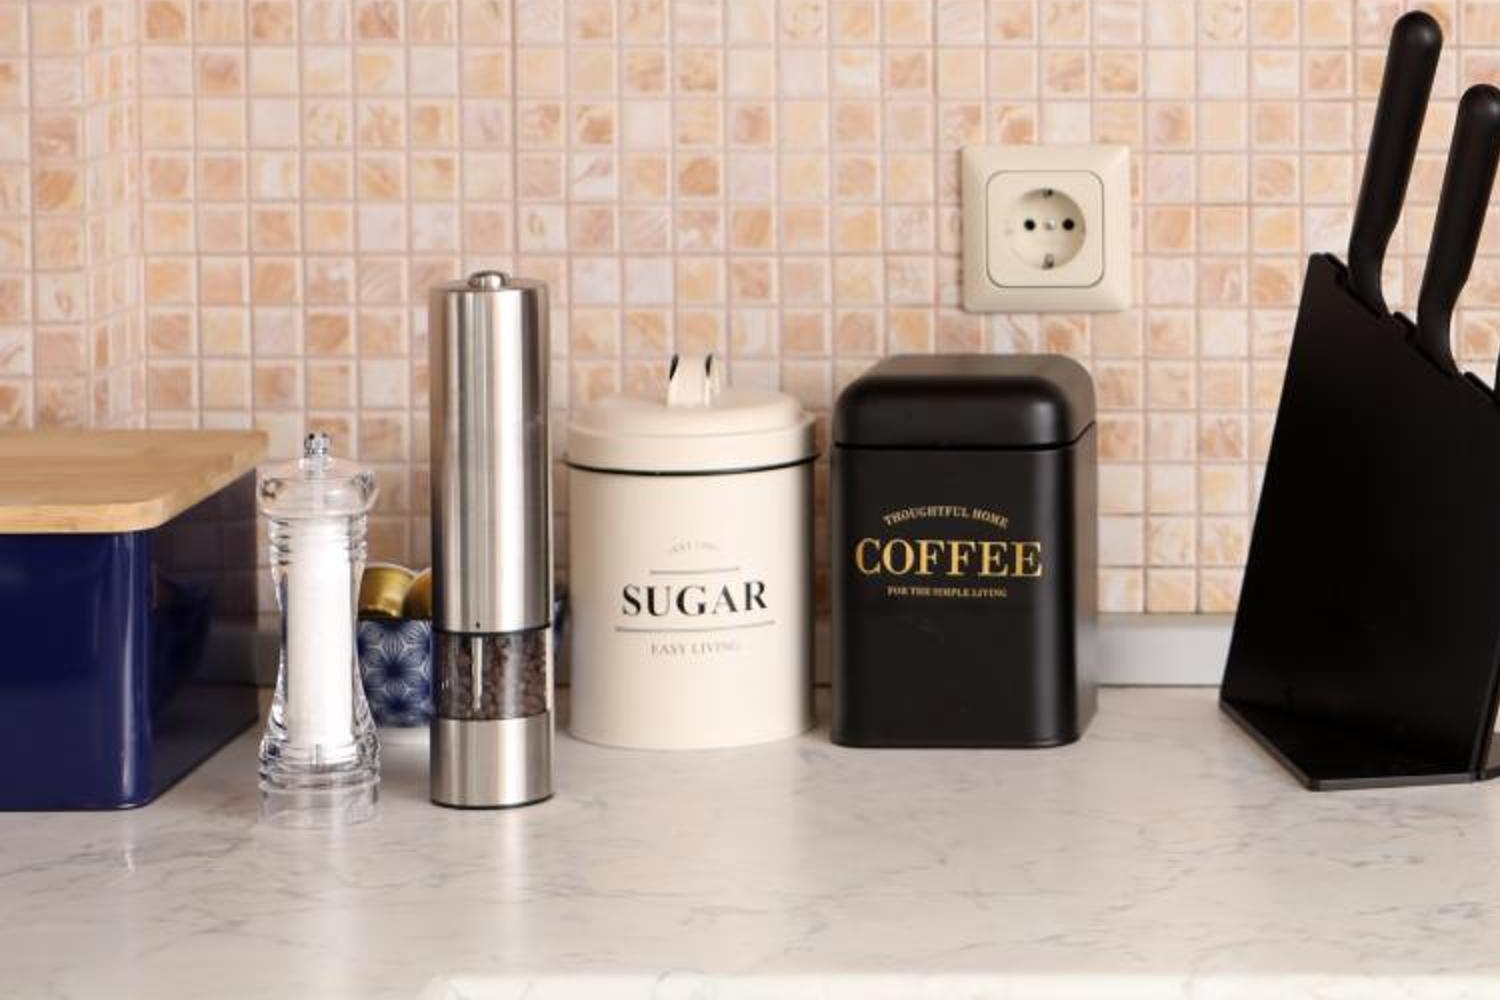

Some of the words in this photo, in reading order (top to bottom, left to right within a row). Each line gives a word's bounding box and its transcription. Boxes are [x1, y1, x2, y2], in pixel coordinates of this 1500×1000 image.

[884, 506, 969, 526] THOUGHTFUL
[972, 508, 1008, 529] HOME
[855, 538, 1043, 577] COFFEE
[622, 581, 768, 617] SUGAR
[887, 586, 908, 597] FOR
[911, 586, 931, 597] THE
[971, 588, 1007, 598] LIVING
[650, 643, 686, 656] EASY
